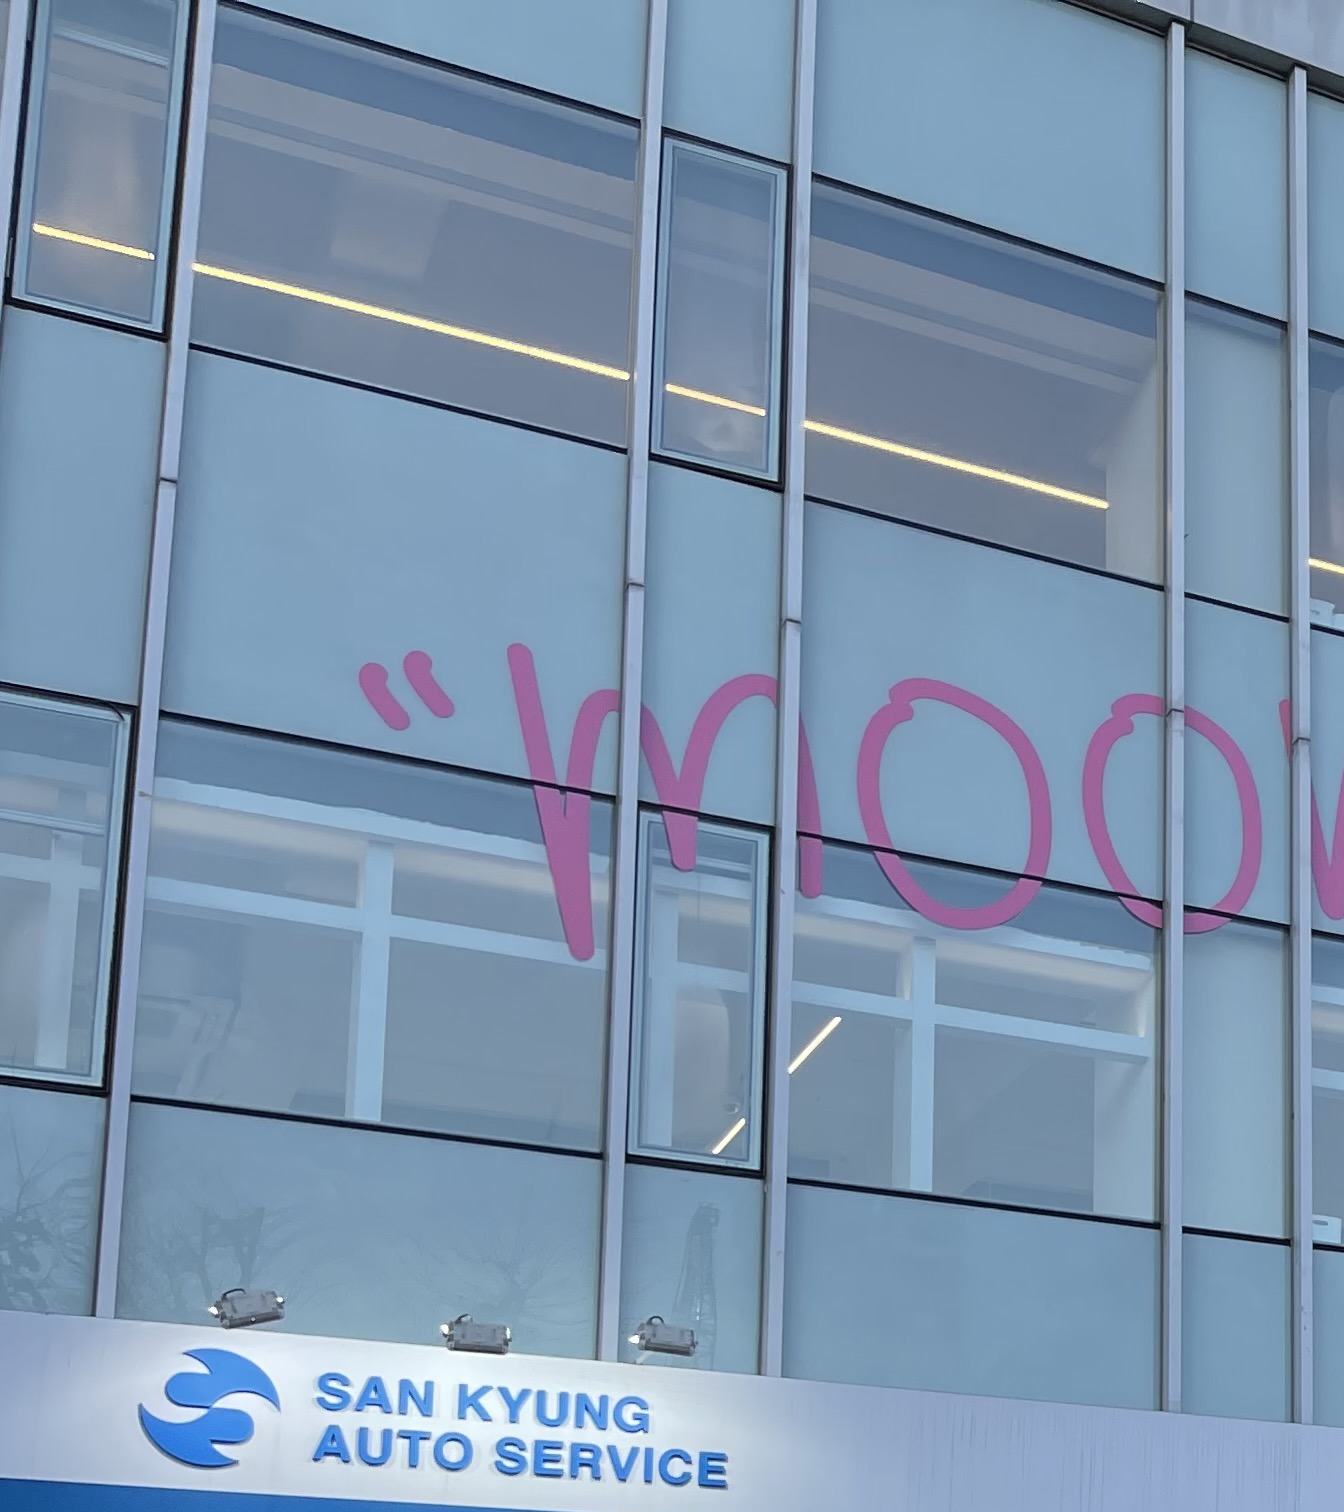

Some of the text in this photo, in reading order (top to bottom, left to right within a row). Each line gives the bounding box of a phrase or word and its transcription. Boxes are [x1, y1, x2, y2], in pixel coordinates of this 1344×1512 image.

[314, 1371, 651, 1434] SAN KYUNG
[312, 1424, 730, 1489] AUTO SERVICE
